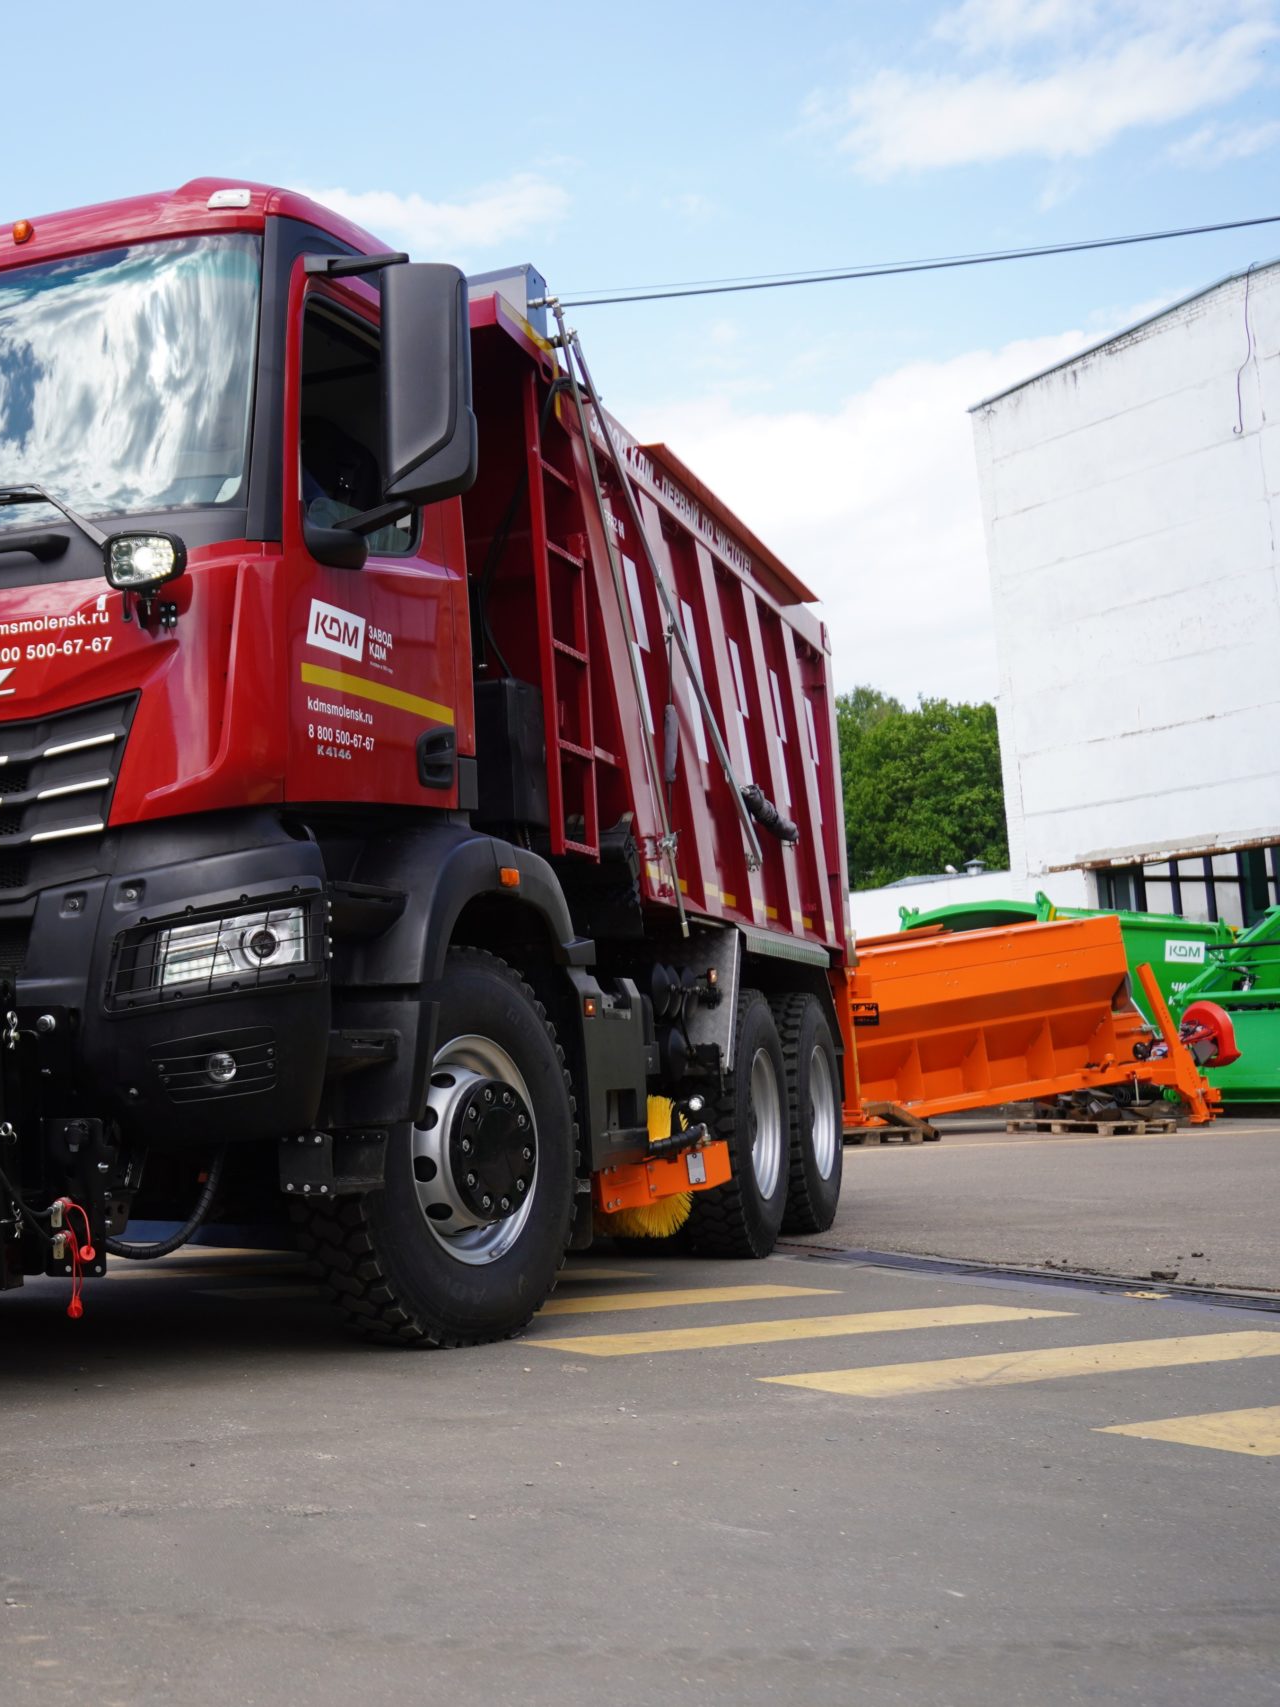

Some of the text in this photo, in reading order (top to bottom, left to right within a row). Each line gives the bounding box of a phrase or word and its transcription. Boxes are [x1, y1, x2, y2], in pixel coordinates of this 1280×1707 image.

[661, 474, 700, 527] ПЕРВЫЙ
[701, 512, 714, 539] ПО
[315, 610, 360, 650] KDM
[368, 624, 393, 650] ЗАВОД
[26, 636, 113, 660] 500-67-67
[368, 641, 387, 661] КДМ
[307, 696, 373, 724] kdmsmolensk.ru
[308, 723, 375, 751] 8 800 500-67-67
[1169, 945, 1201, 958] KDM
